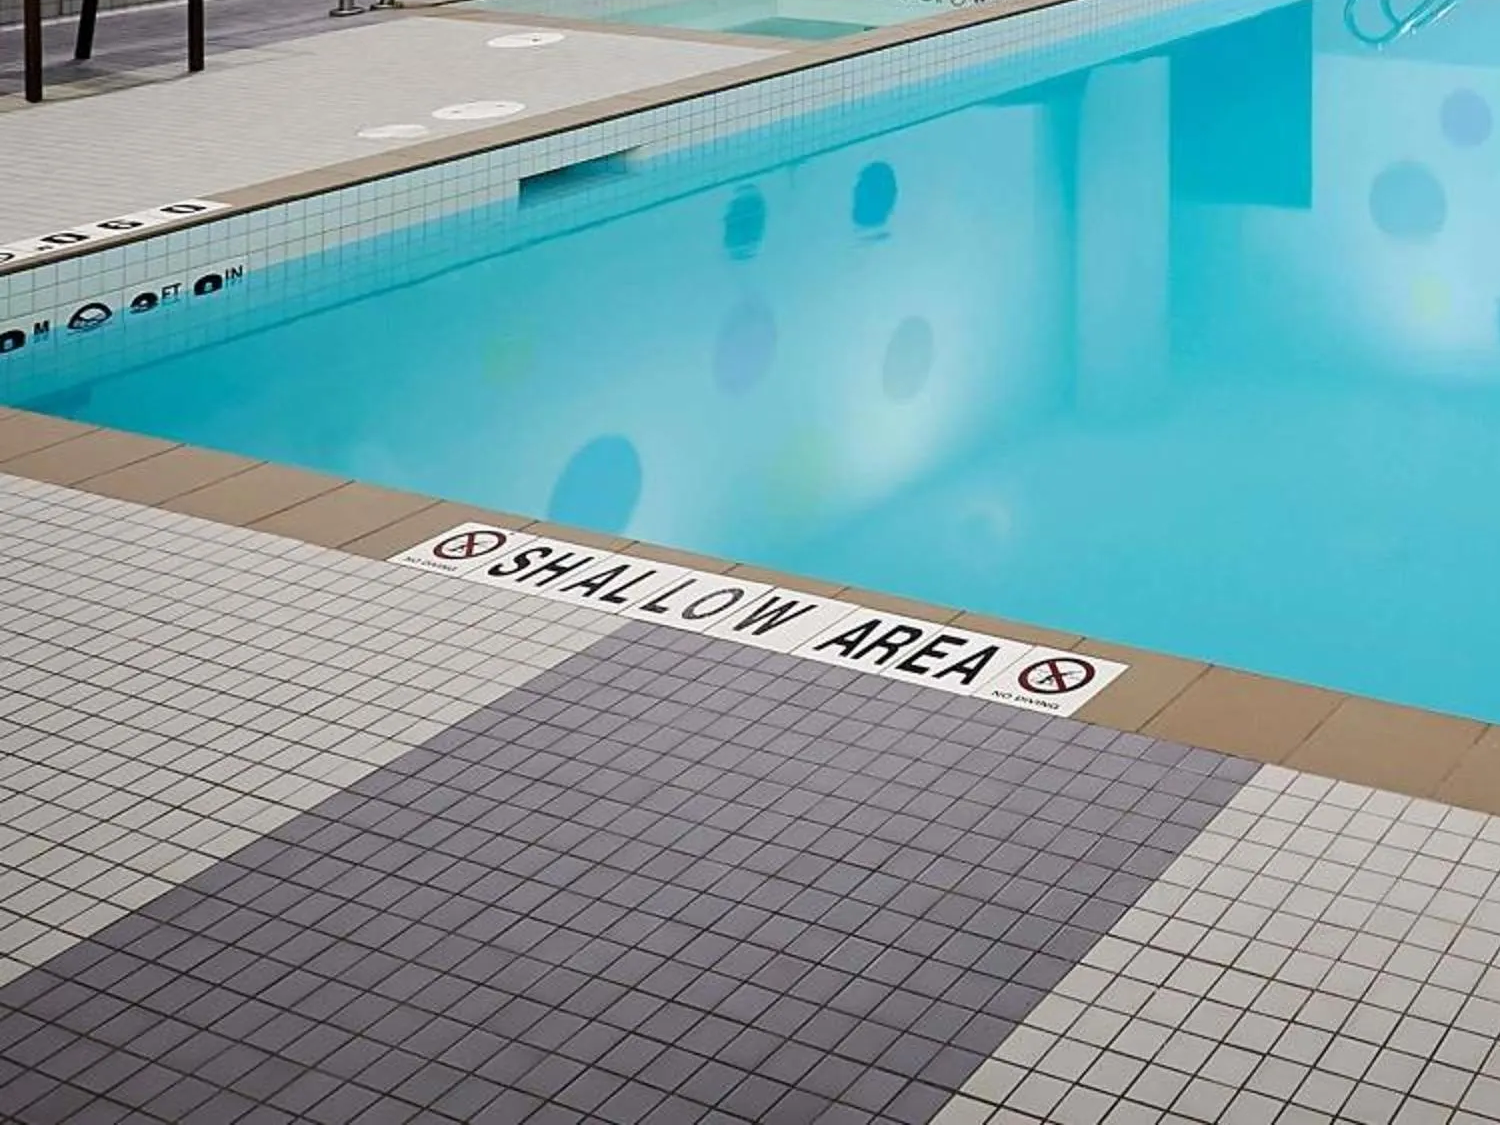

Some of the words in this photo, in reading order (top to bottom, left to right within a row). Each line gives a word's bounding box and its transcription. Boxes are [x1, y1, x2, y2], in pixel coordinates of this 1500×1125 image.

[225, 265, 243, 279] IN
[488, 546, 818, 636] SHALLOW
[813, 619, 1001, 686] AREA
[991, 690, 1013, 699] NO
[1014, 696, 1060, 710] DIVING
